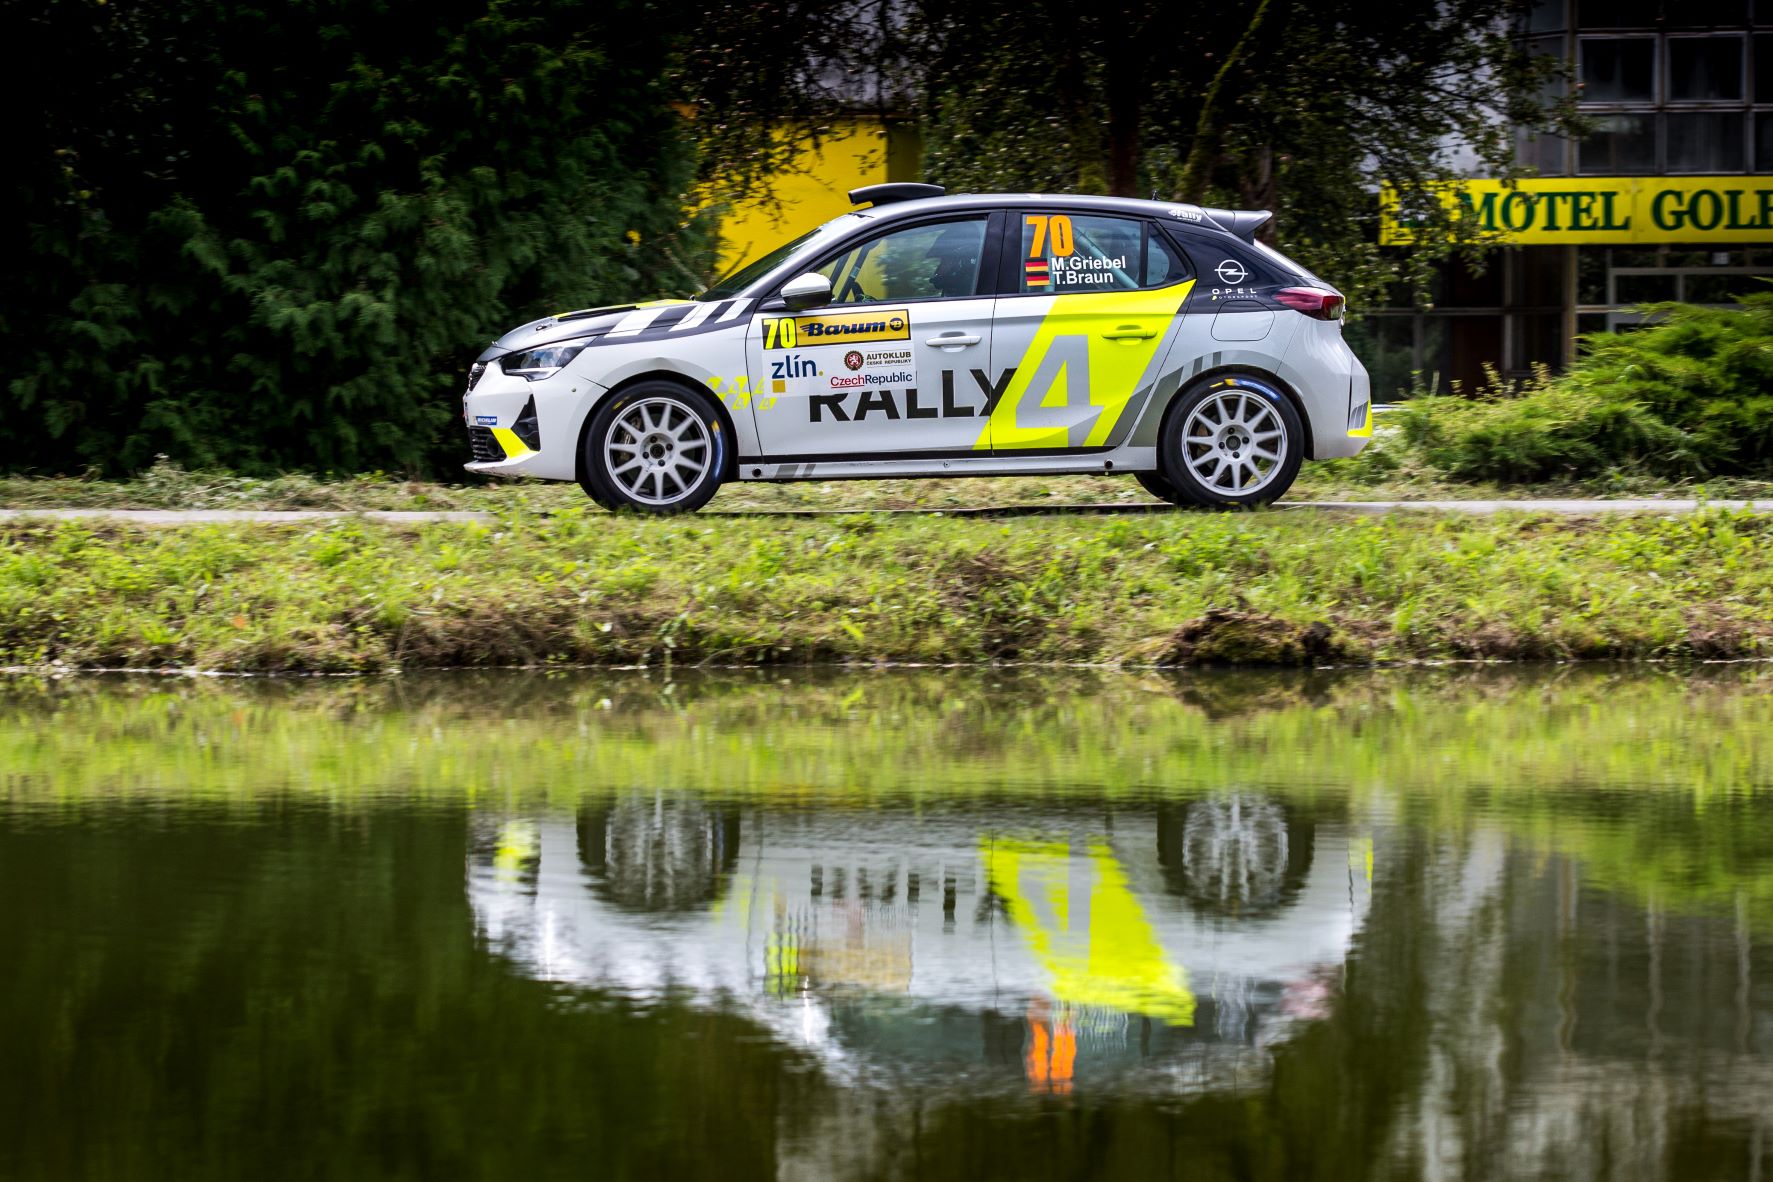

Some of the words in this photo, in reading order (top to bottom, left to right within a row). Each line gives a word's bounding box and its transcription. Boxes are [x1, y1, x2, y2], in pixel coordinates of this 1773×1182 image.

[1457, 190, 1631, 232] MOTEL
[1026, 215, 1074, 257] 70
[1051, 255, 1126, 271] M.Griebel
[1053, 271, 1114, 285] T.Braun
[763, 317, 797, 350] 70
[800, 322, 886, 337] Barum
[866, 352, 912, 360] AUTOKLUB
[809, 367, 1017, 422] RALLY
